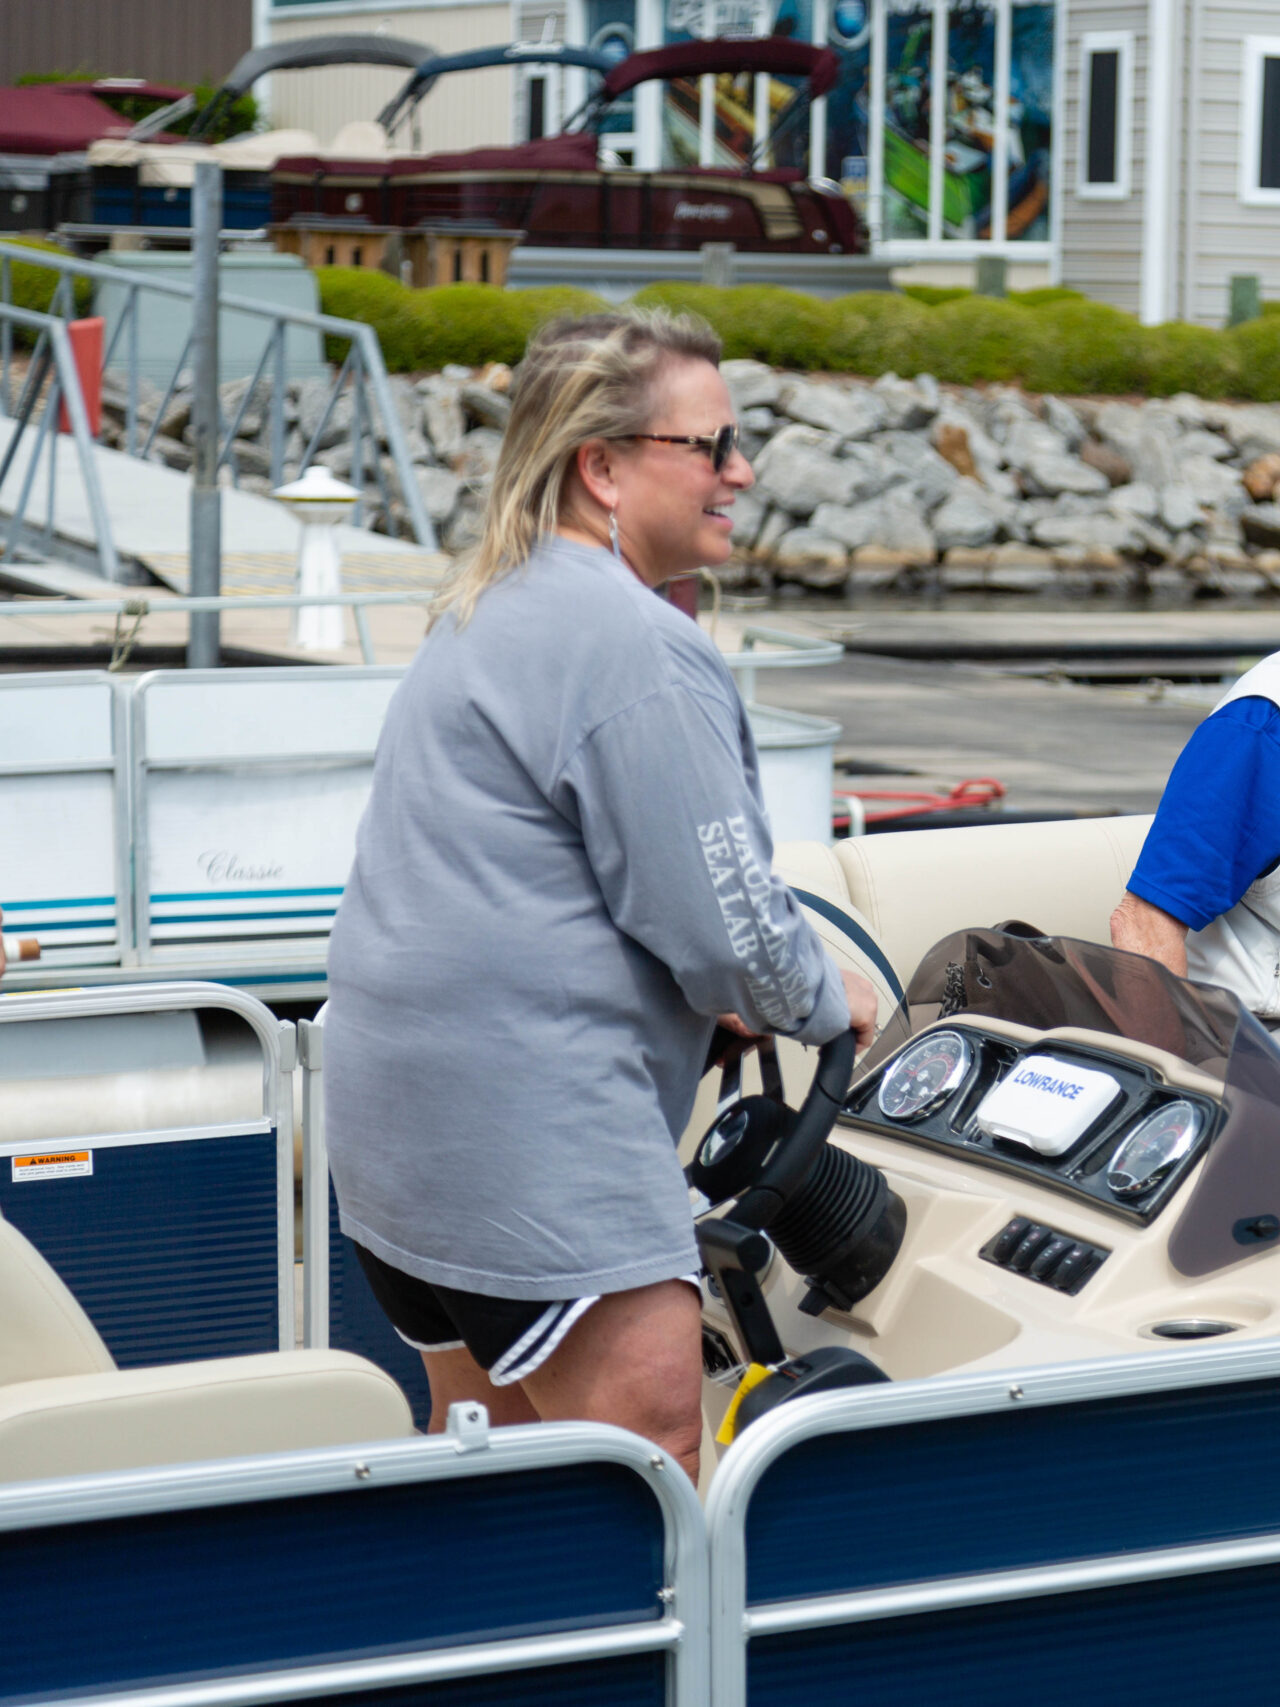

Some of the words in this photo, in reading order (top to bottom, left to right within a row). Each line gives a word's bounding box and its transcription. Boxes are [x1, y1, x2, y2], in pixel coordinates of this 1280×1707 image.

[197, 849, 284, 886] Classic
[697, 820, 737, 889] SEA
[717, 888, 760, 960] LAB
[1013, 1069, 1085, 1100] LOWRANCE
[38, 1155, 76, 1164] WARNING
